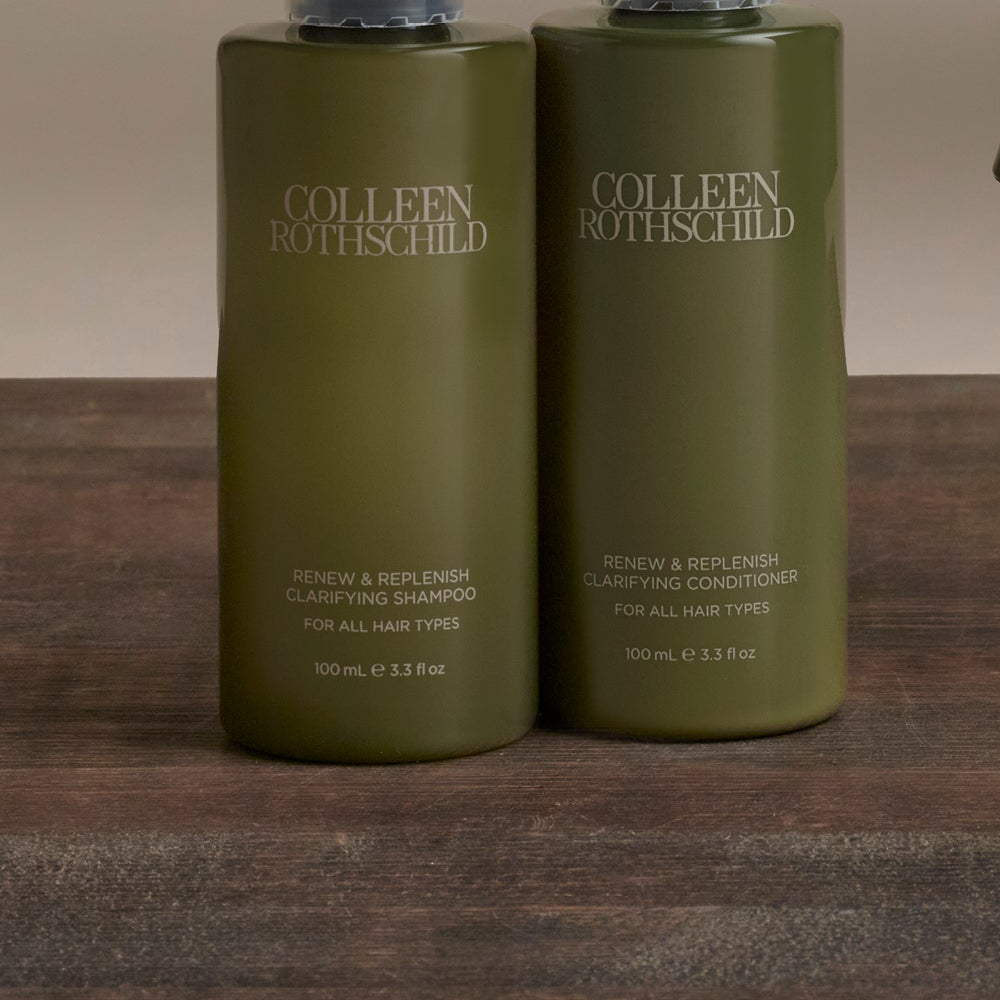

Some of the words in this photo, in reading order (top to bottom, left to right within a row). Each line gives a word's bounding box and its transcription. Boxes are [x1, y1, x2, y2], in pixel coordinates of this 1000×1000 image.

[591, 170, 780, 210] COLLEEN
[284, 184, 473, 224] COLLEEN
[578, 206, 795, 243] ROTHSCHILD
[270, 218, 487, 257] ROTHSCHILD
[603, 554, 665, 571] RENEW
[671, 558, 682, 571] &
[688, 553, 779, 571] REPLENISH
[293, 569, 356, 586] RENEW
[361, 572, 373, 586] &
[378, 568, 469, 586] REPLENISH
[583, 572, 681, 590] CLARIFYING
[687, 569, 798, 590] CONDITIONER
[286, 587, 388, 605] CLARIFYING
[394, 587, 476, 605] SHAMPOO
[615, 603, 645, 616] FOR
[650, 605, 678, 617] ALL
[684, 605, 720, 617] HAIR
[725, 601, 770, 616] TYPES
[304, 617, 334, 632] FOR
[339, 620, 368, 632] ALL
[373, 620, 410, 632] HAIR
[415, 617, 460, 631] TYPES
[625, 647, 651, 660] 100
[654, 649, 677, 661] mL
[701, 648, 722, 661] 3.3
[314, 662, 340, 676] 100
[343, 664, 367, 677] mL
[390, 664, 412, 677] 3.3
